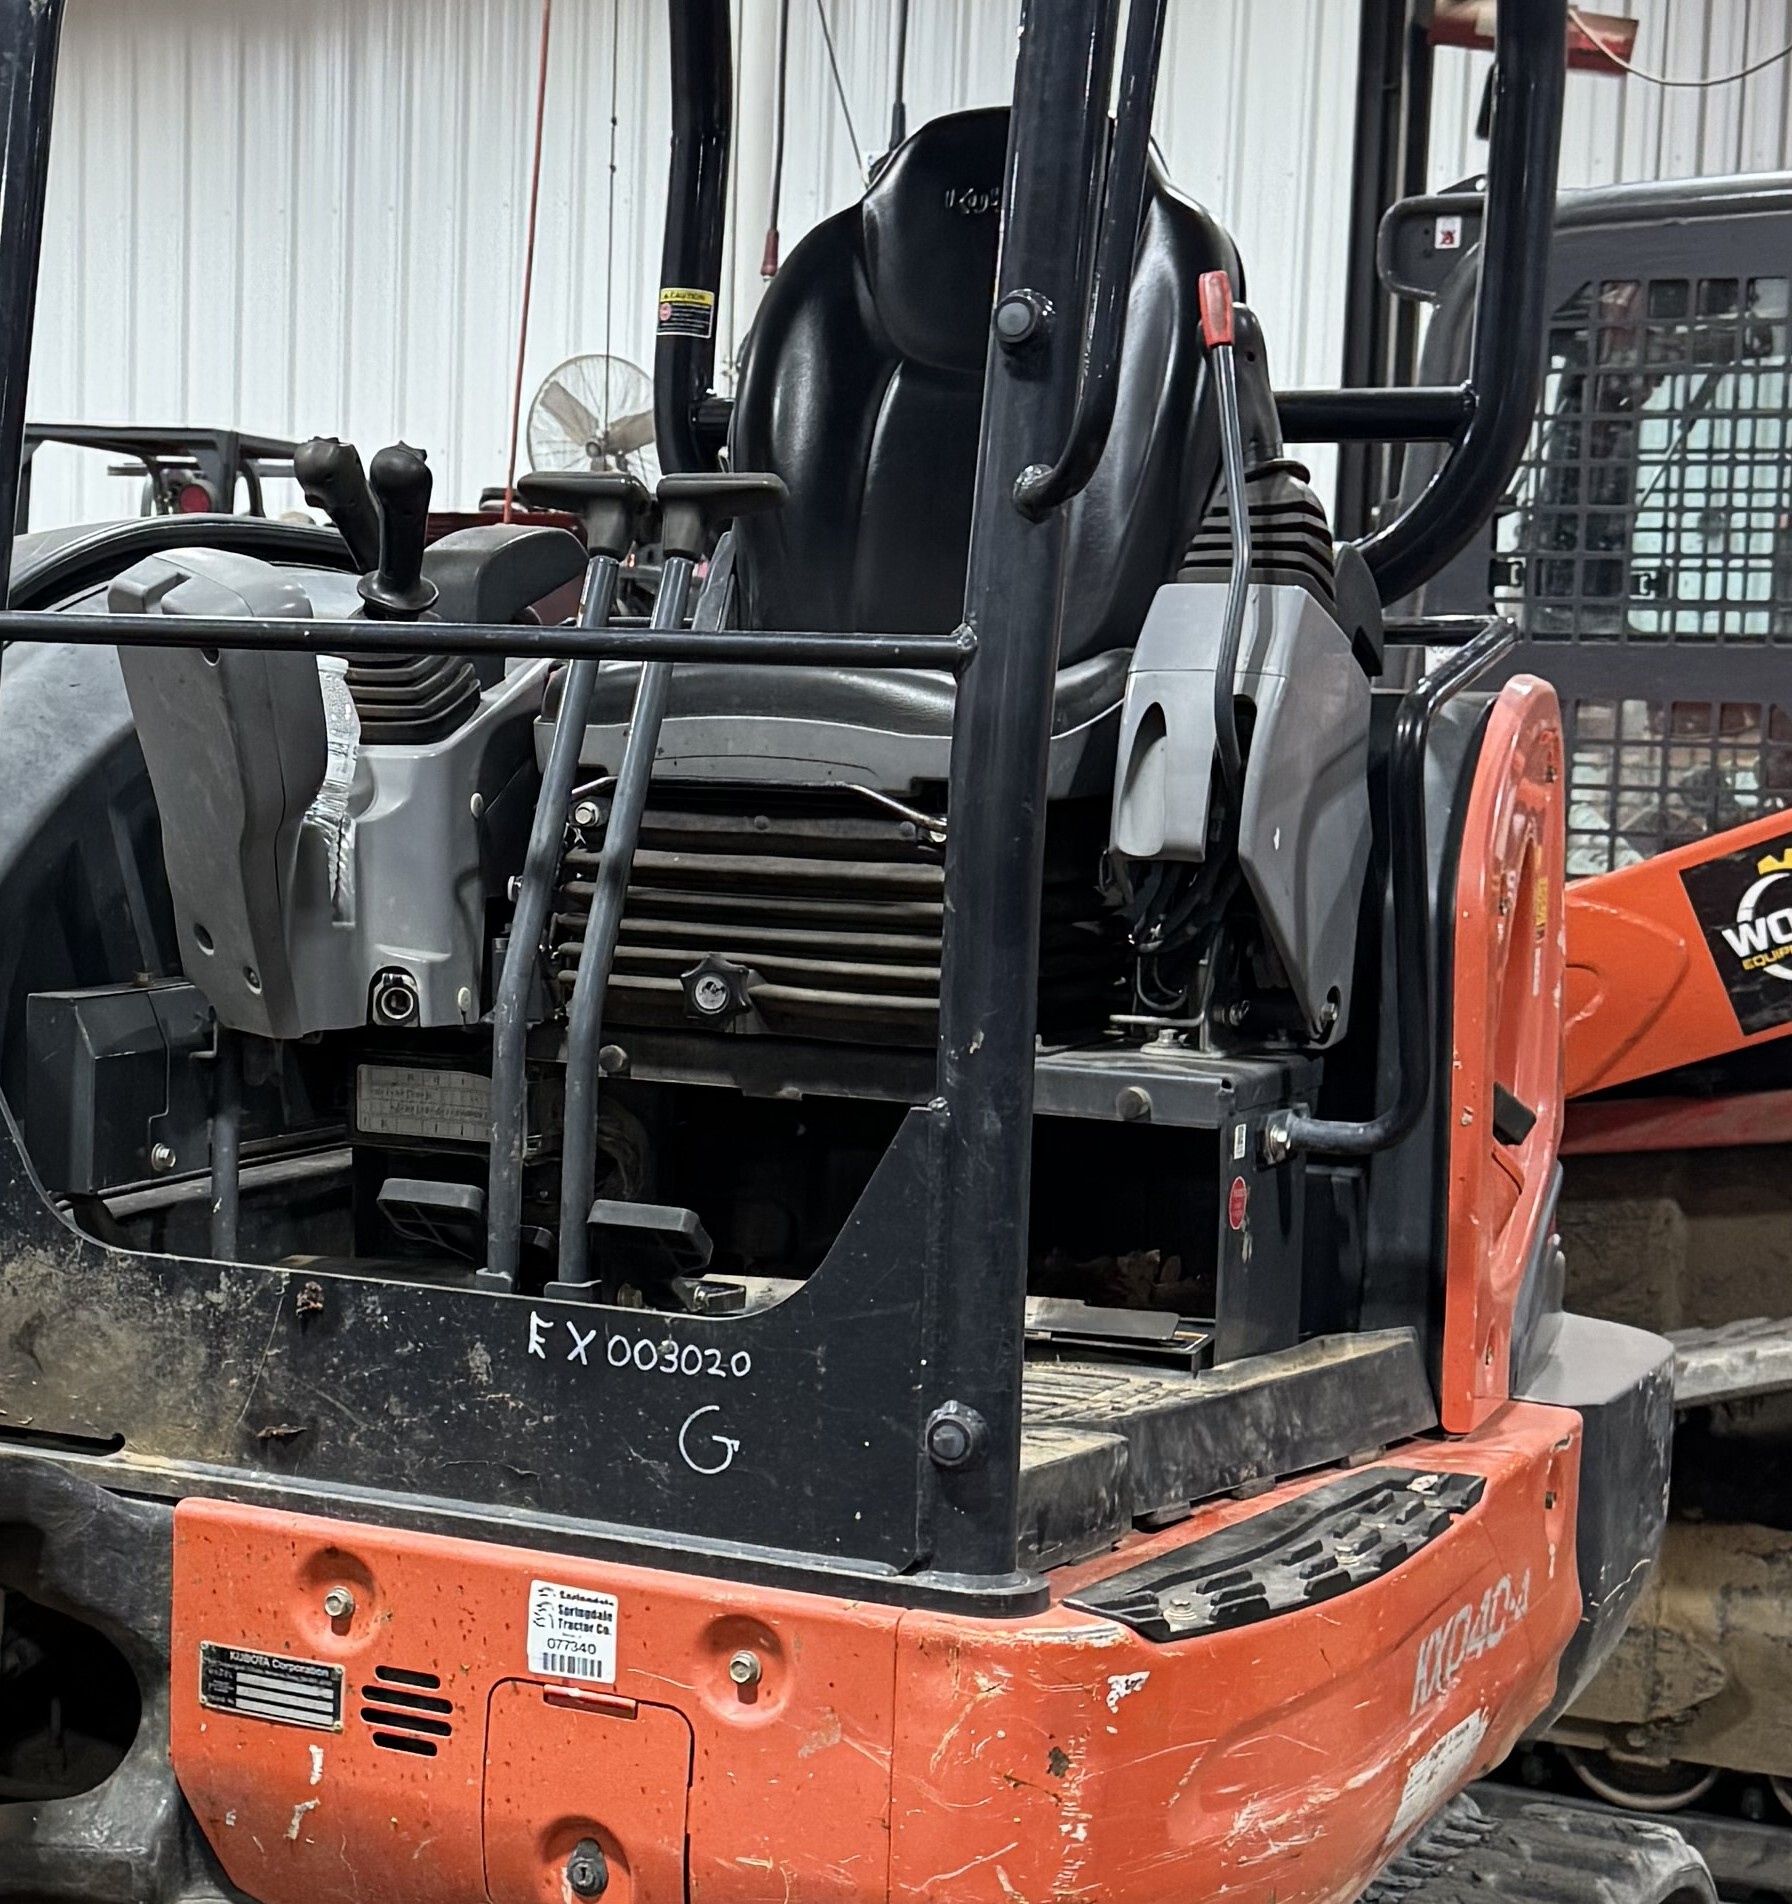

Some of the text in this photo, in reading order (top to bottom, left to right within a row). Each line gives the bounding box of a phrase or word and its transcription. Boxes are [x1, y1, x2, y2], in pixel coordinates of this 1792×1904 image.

[1742, 944, 1792, 971] EQUIP
[679, 1405, 741, 1475] G
[558, 1618, 594, 1633] Tractor
[547, 1637, 597, 1655] 077340
